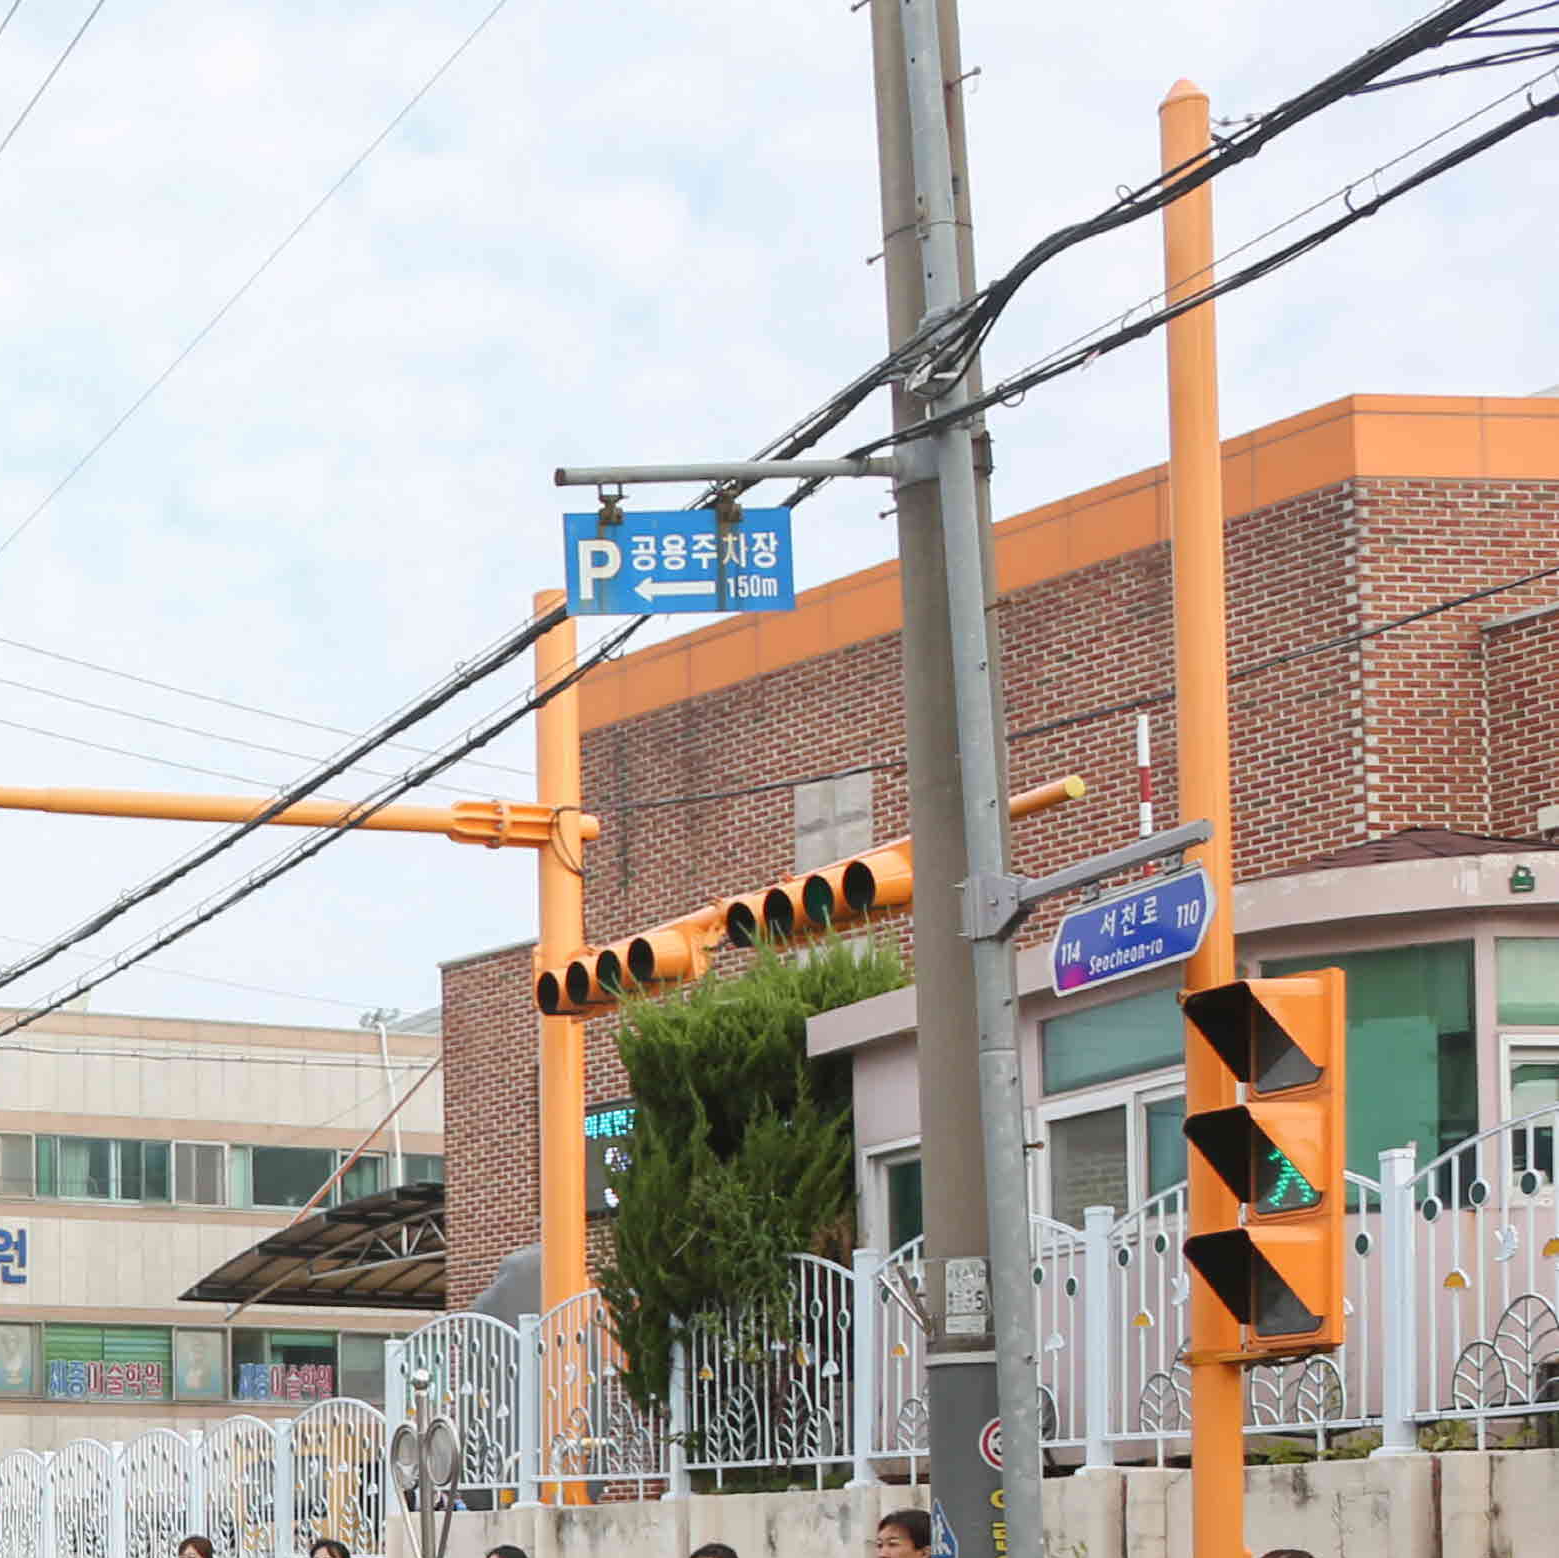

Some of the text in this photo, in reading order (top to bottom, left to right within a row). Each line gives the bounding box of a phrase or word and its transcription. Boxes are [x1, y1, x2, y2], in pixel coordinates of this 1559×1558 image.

[577, 539, 622, 600] P
[630, 531, 779, 571] 공용주차장
[727, 574, 778, 598] 150m
[1099, 895, 1158, 937] 서천로
[1176, 899, 1200, 929] 110
[1061, 939, 1082, 967] 114
[1088, 937, 1164, 976] Seocheon-ro
